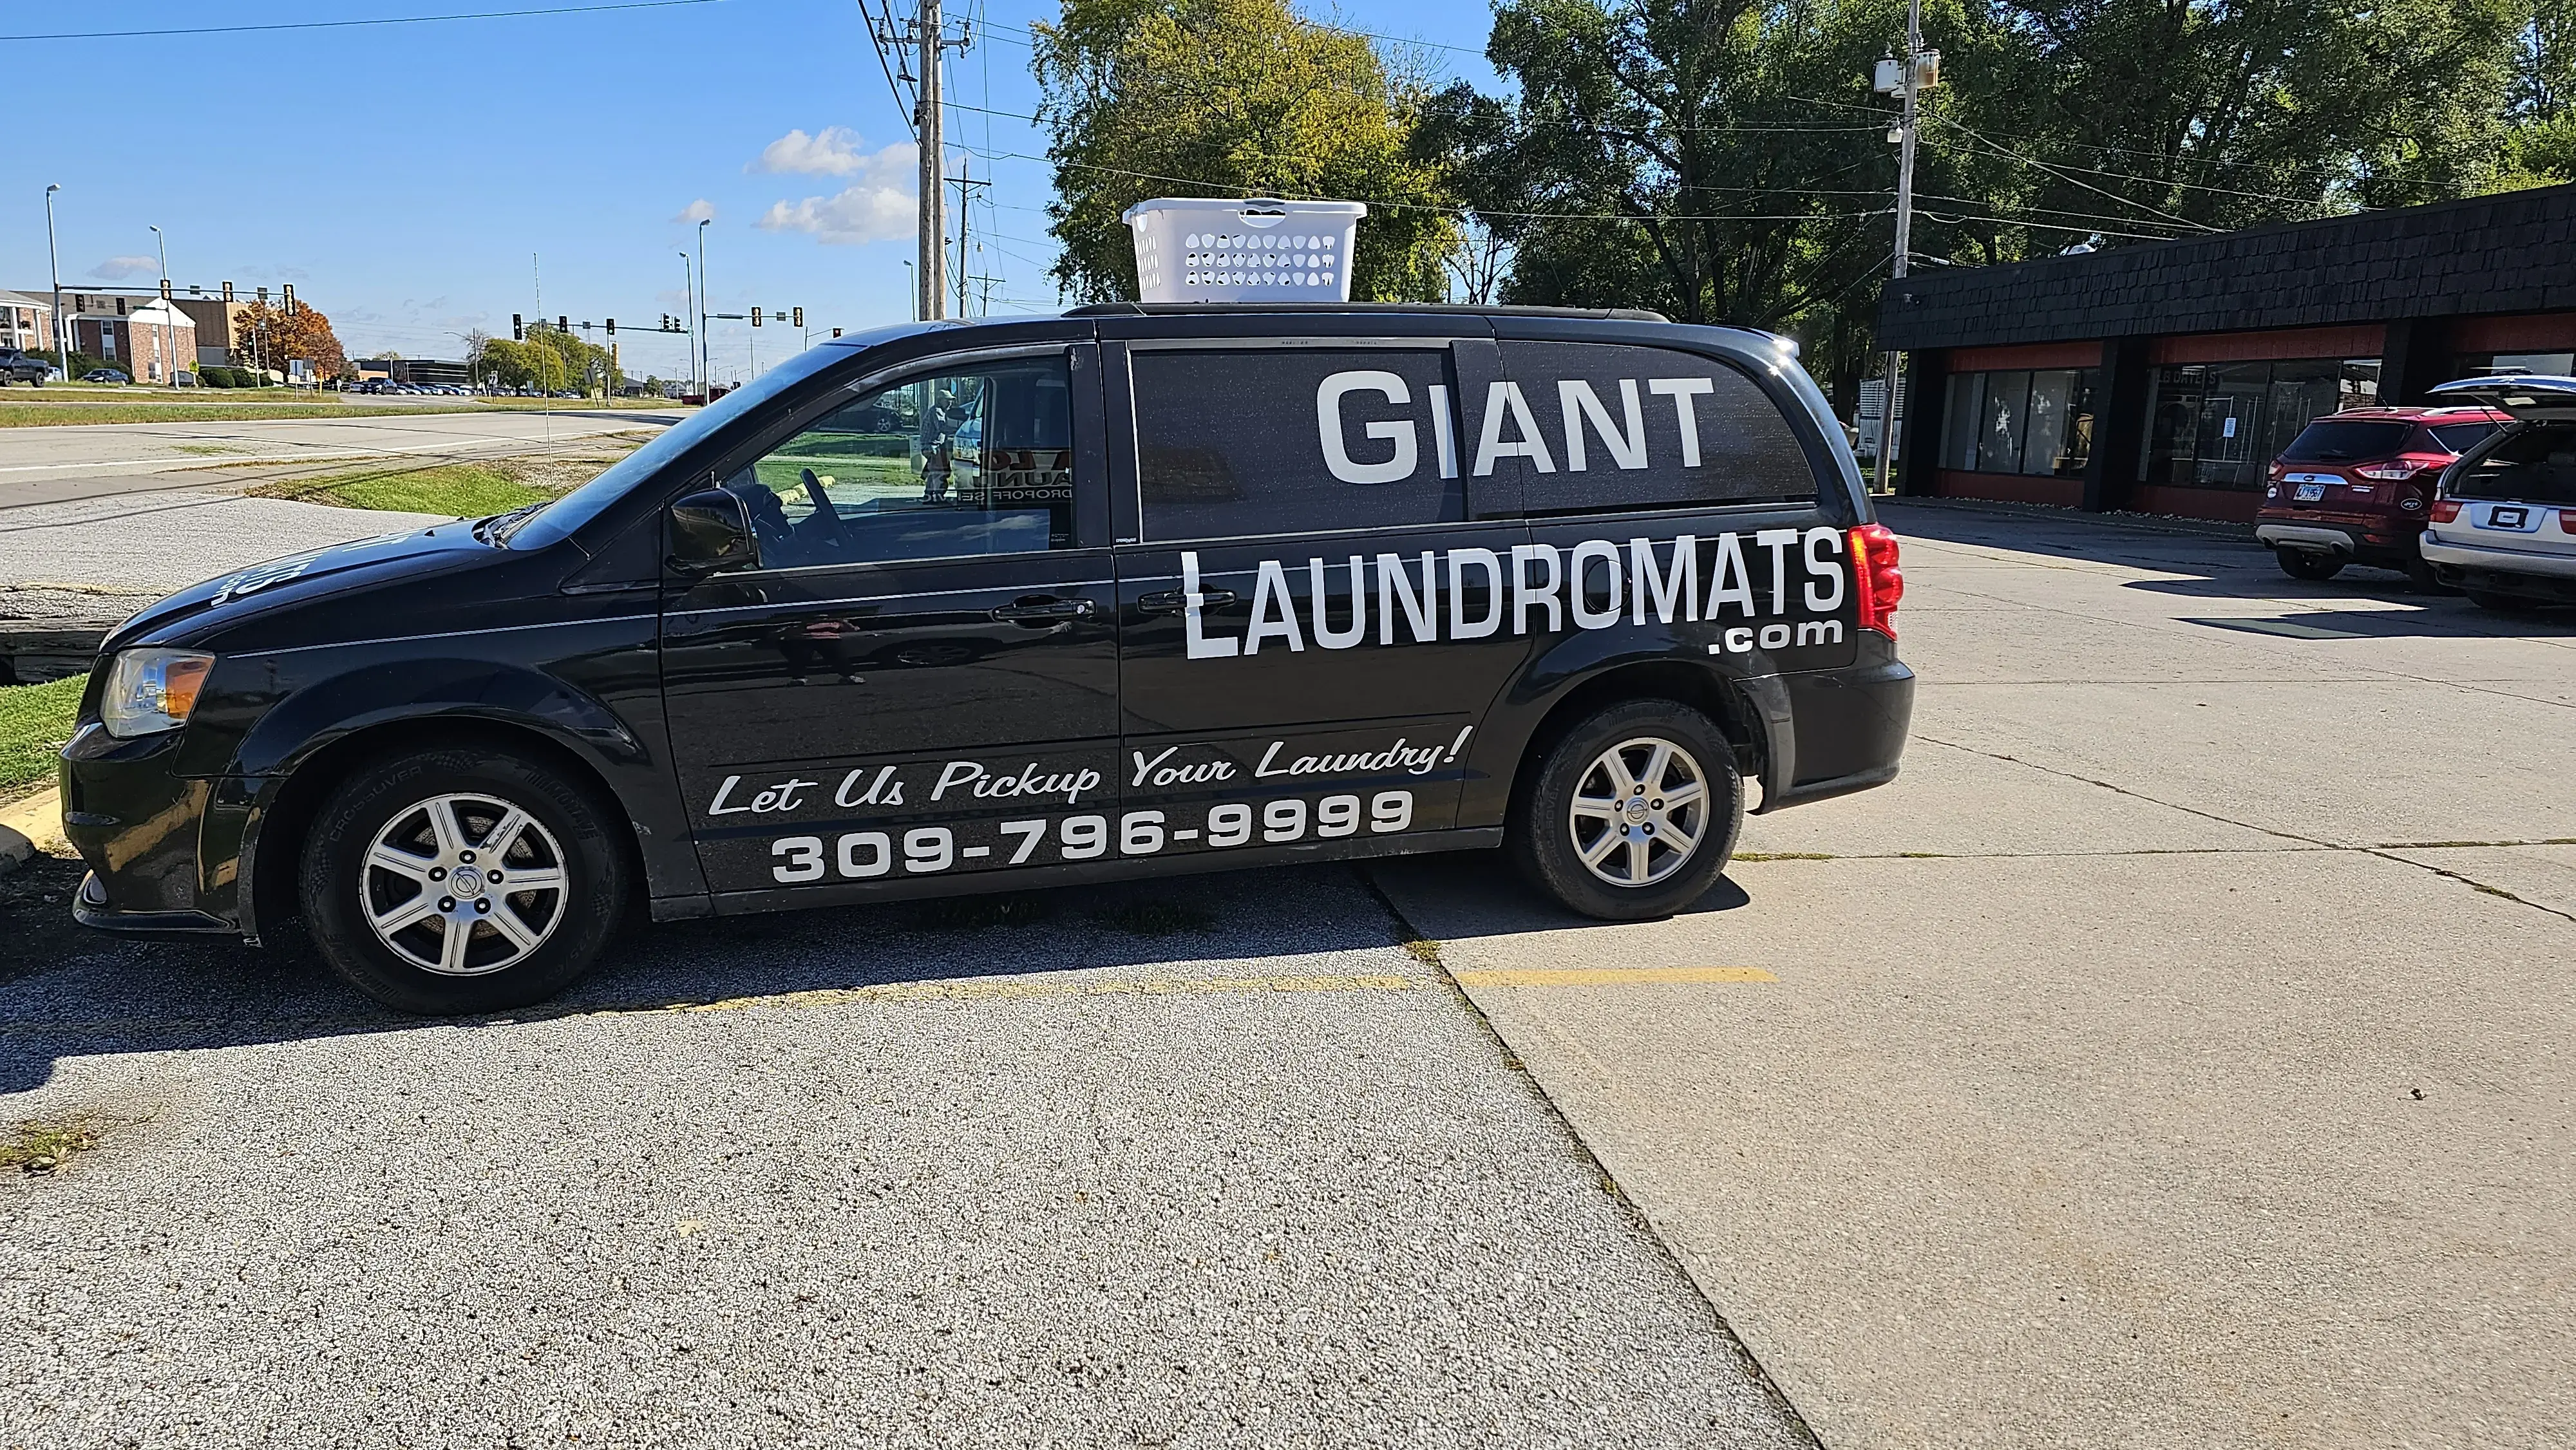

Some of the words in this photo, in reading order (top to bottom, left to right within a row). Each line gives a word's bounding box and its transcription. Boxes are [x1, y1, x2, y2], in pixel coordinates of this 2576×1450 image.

[1317, 371, 1714, 484] GIANT
[1181, 526, 1844, 661] LAUNDROMATS
[1707, 619, 1844, 657] .com
[709, 775, 818, 816] Let
[835, 764, 905, 808] Us
[931, 761, 1101, 804] Pickup
[1132, 746, 1237, 787] Your
[1255, 725, 1473, 781] Laundry!
[772, 791, 1413, 883] 309-796-9999
